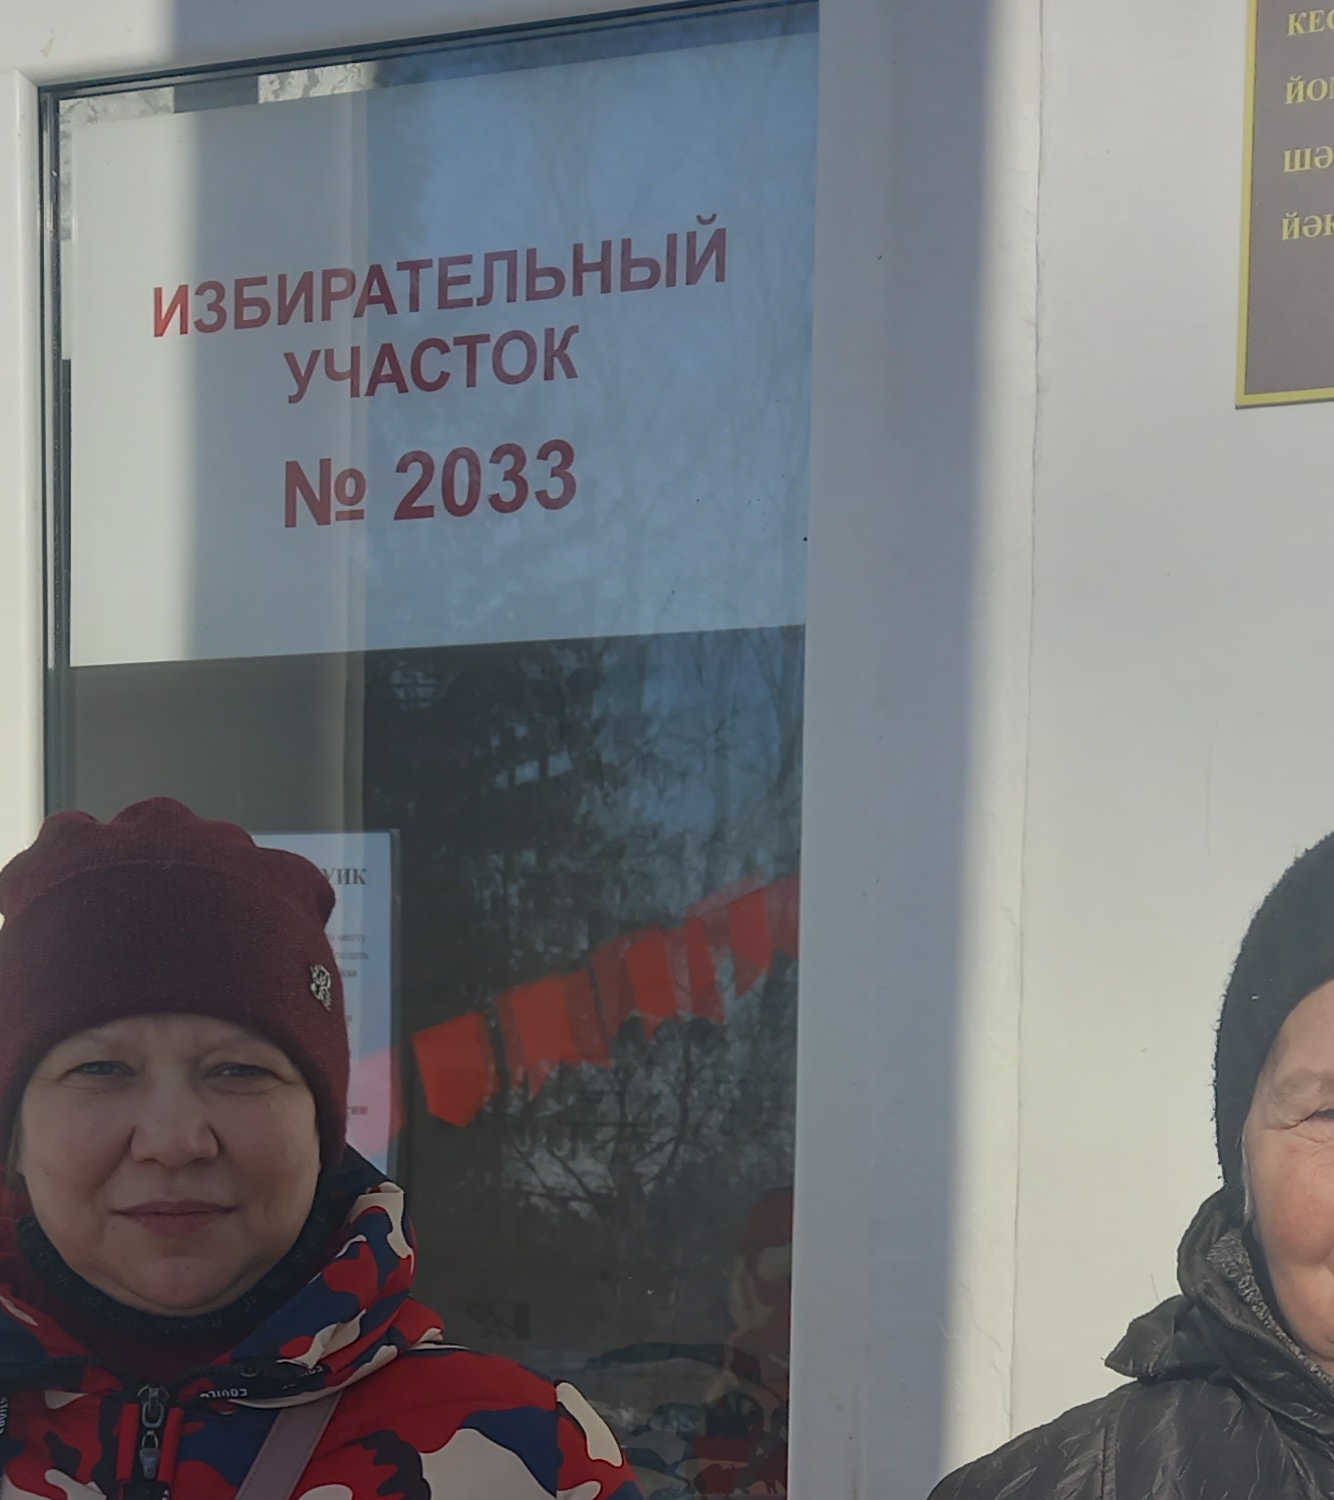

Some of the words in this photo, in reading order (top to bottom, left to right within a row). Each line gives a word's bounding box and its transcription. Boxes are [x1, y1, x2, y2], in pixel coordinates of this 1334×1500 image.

[152, 213, 726, 338] ИЗБИРАТЕЛЬНЫЙ
[283, 325, 579, 403] УЧАСТОК
[283, 458, 366, 528] №
[393, 439, 576, 521] 2033
